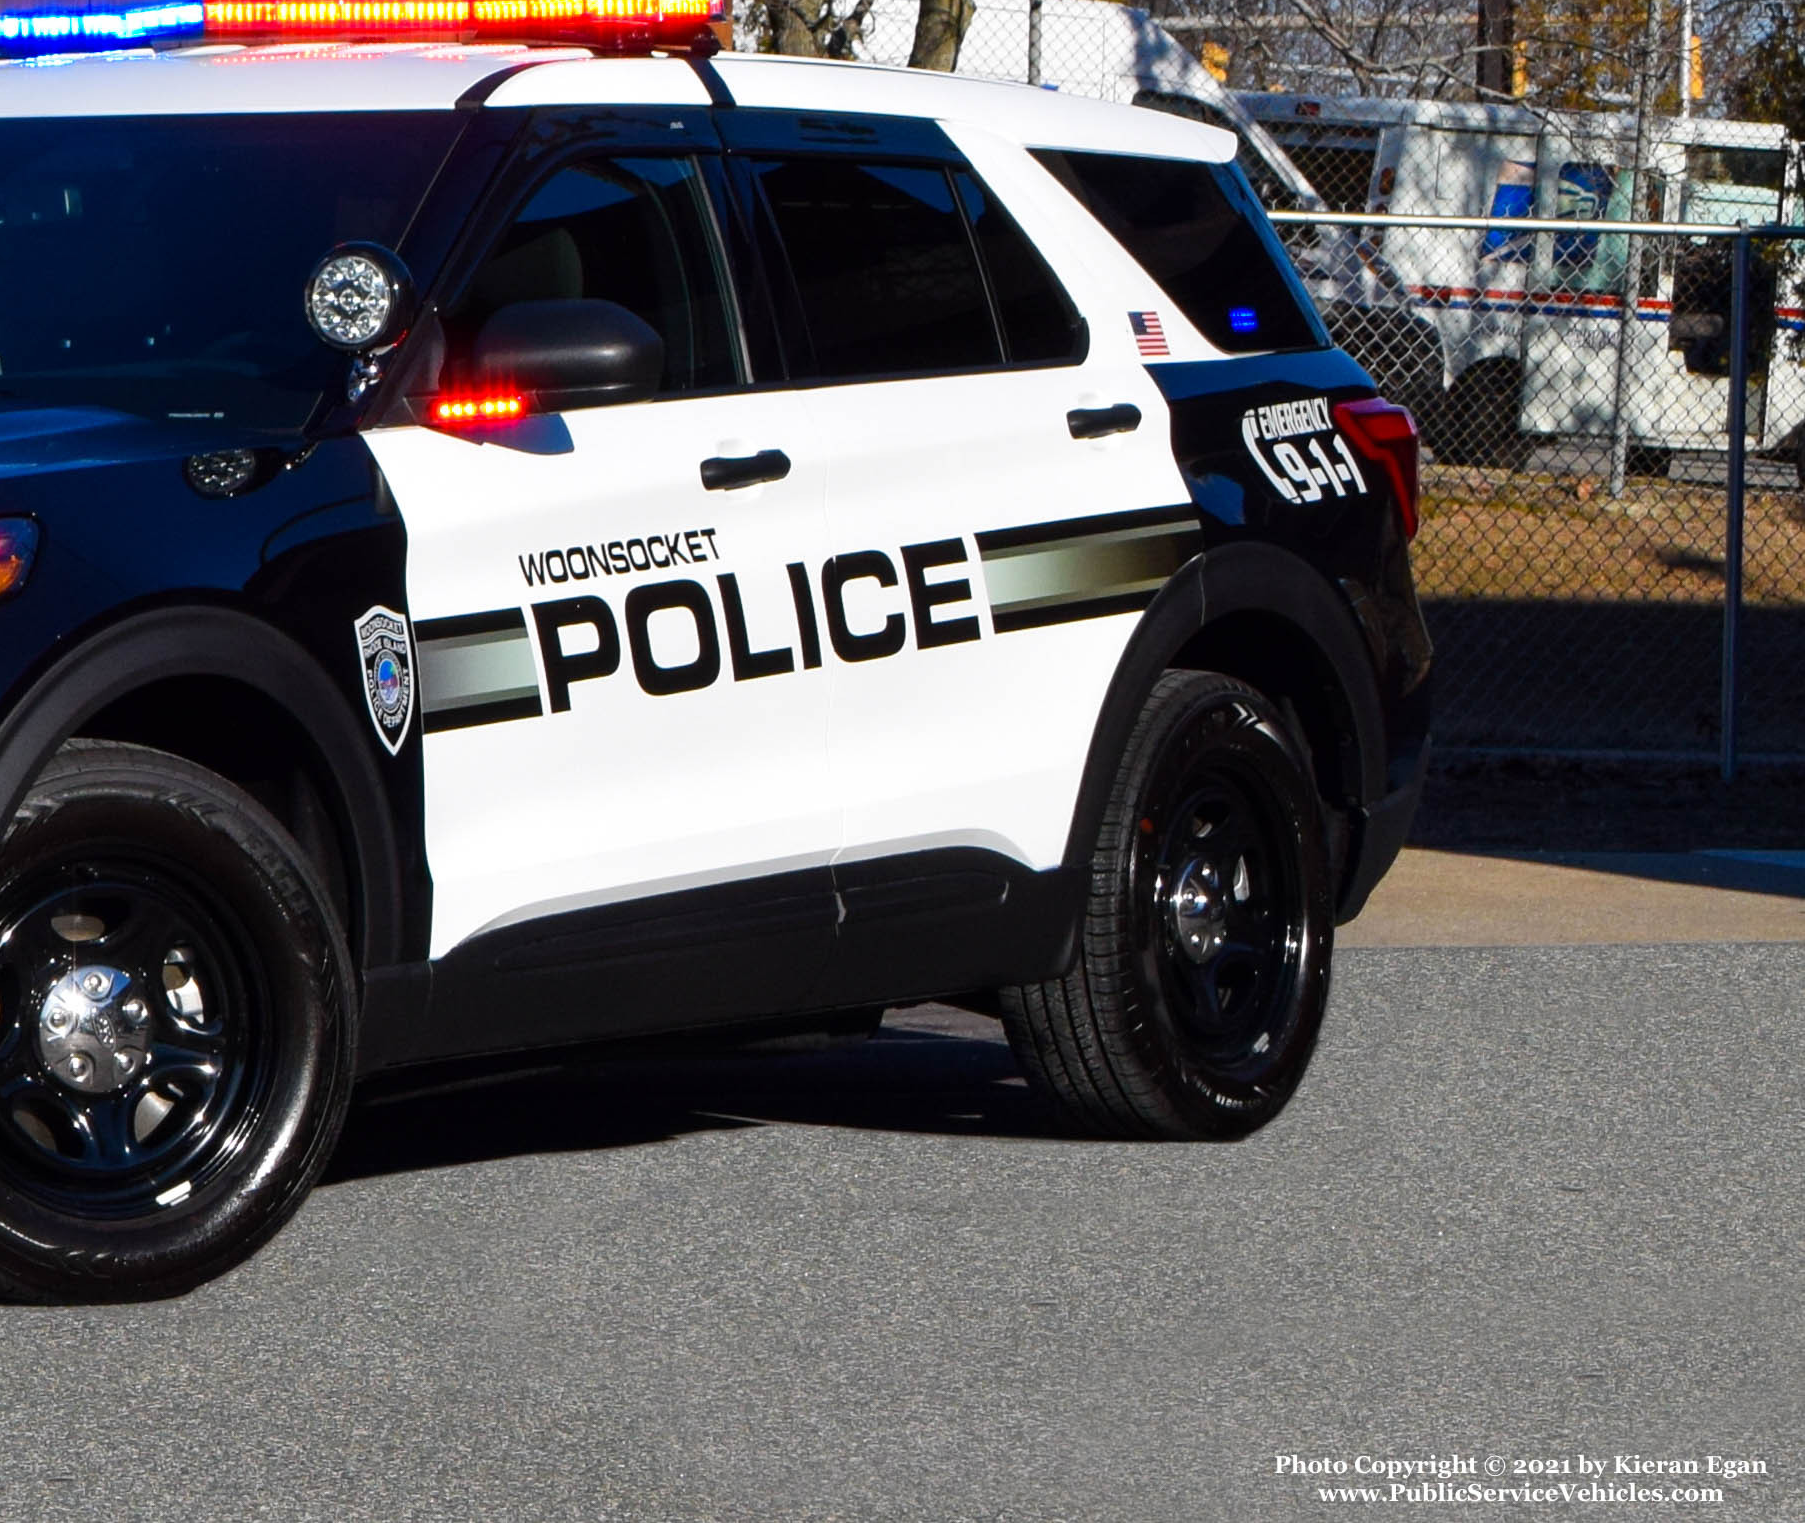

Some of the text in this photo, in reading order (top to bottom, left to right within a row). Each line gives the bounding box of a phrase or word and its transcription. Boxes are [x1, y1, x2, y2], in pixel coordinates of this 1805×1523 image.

[1257, 396, 1333, 440] EMERGENCY
[518, 527, 721, 588] WOONSOCKET
[361, 616, 403, 639] WOONSOCKET
[529, 536, 982, 714] POLICE
[366, 669, 383, 720] POLICE
